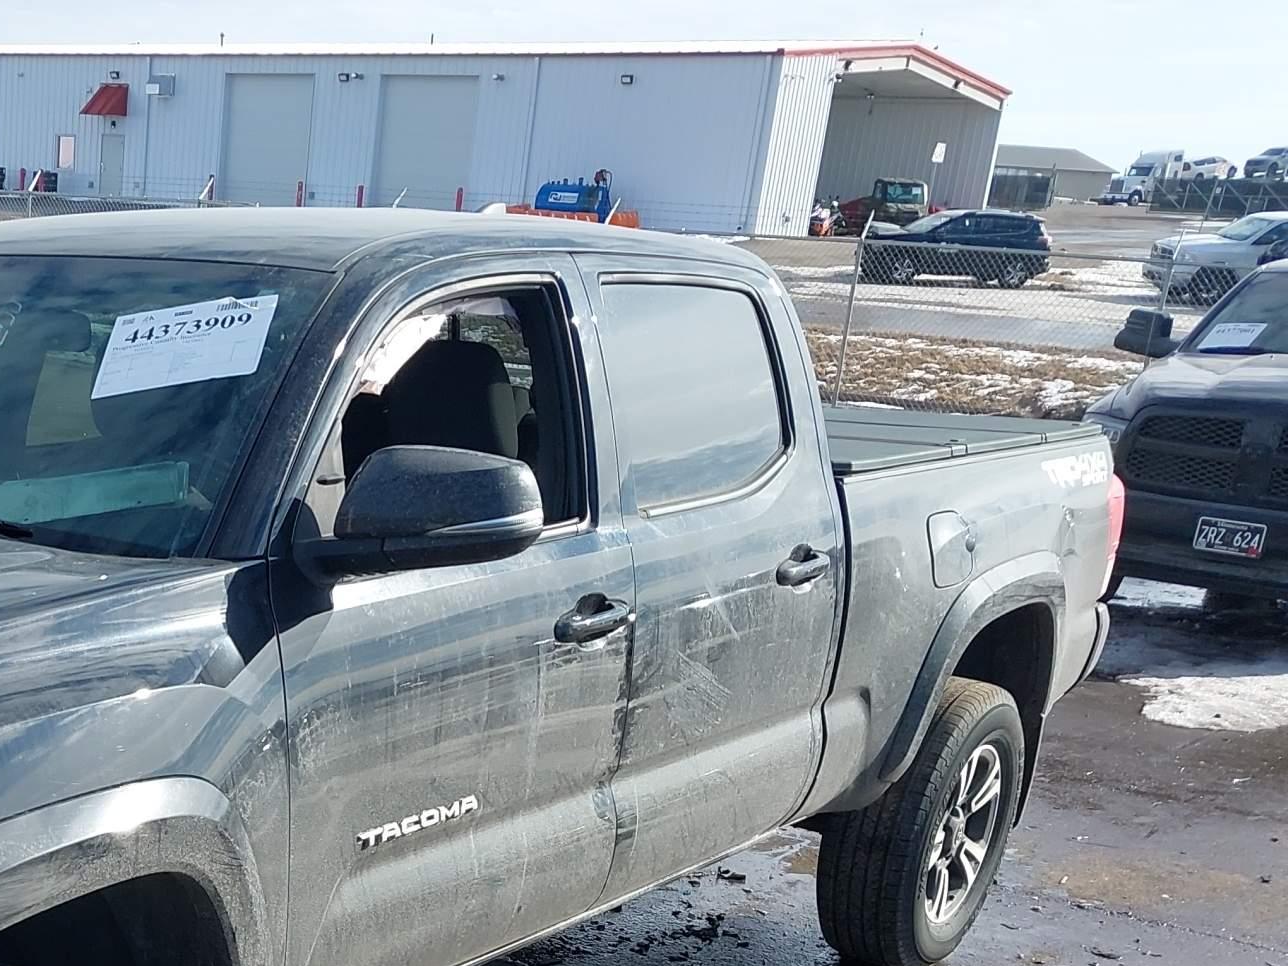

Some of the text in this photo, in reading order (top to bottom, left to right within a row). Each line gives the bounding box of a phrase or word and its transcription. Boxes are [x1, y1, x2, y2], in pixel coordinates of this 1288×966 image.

[124, 312, 253, 344] 44373909
[1198, 525, 1226, 545] ZRZ
[1233, 531, 1260, 550] 624
[357, 794, 479, 848] TACOMA
